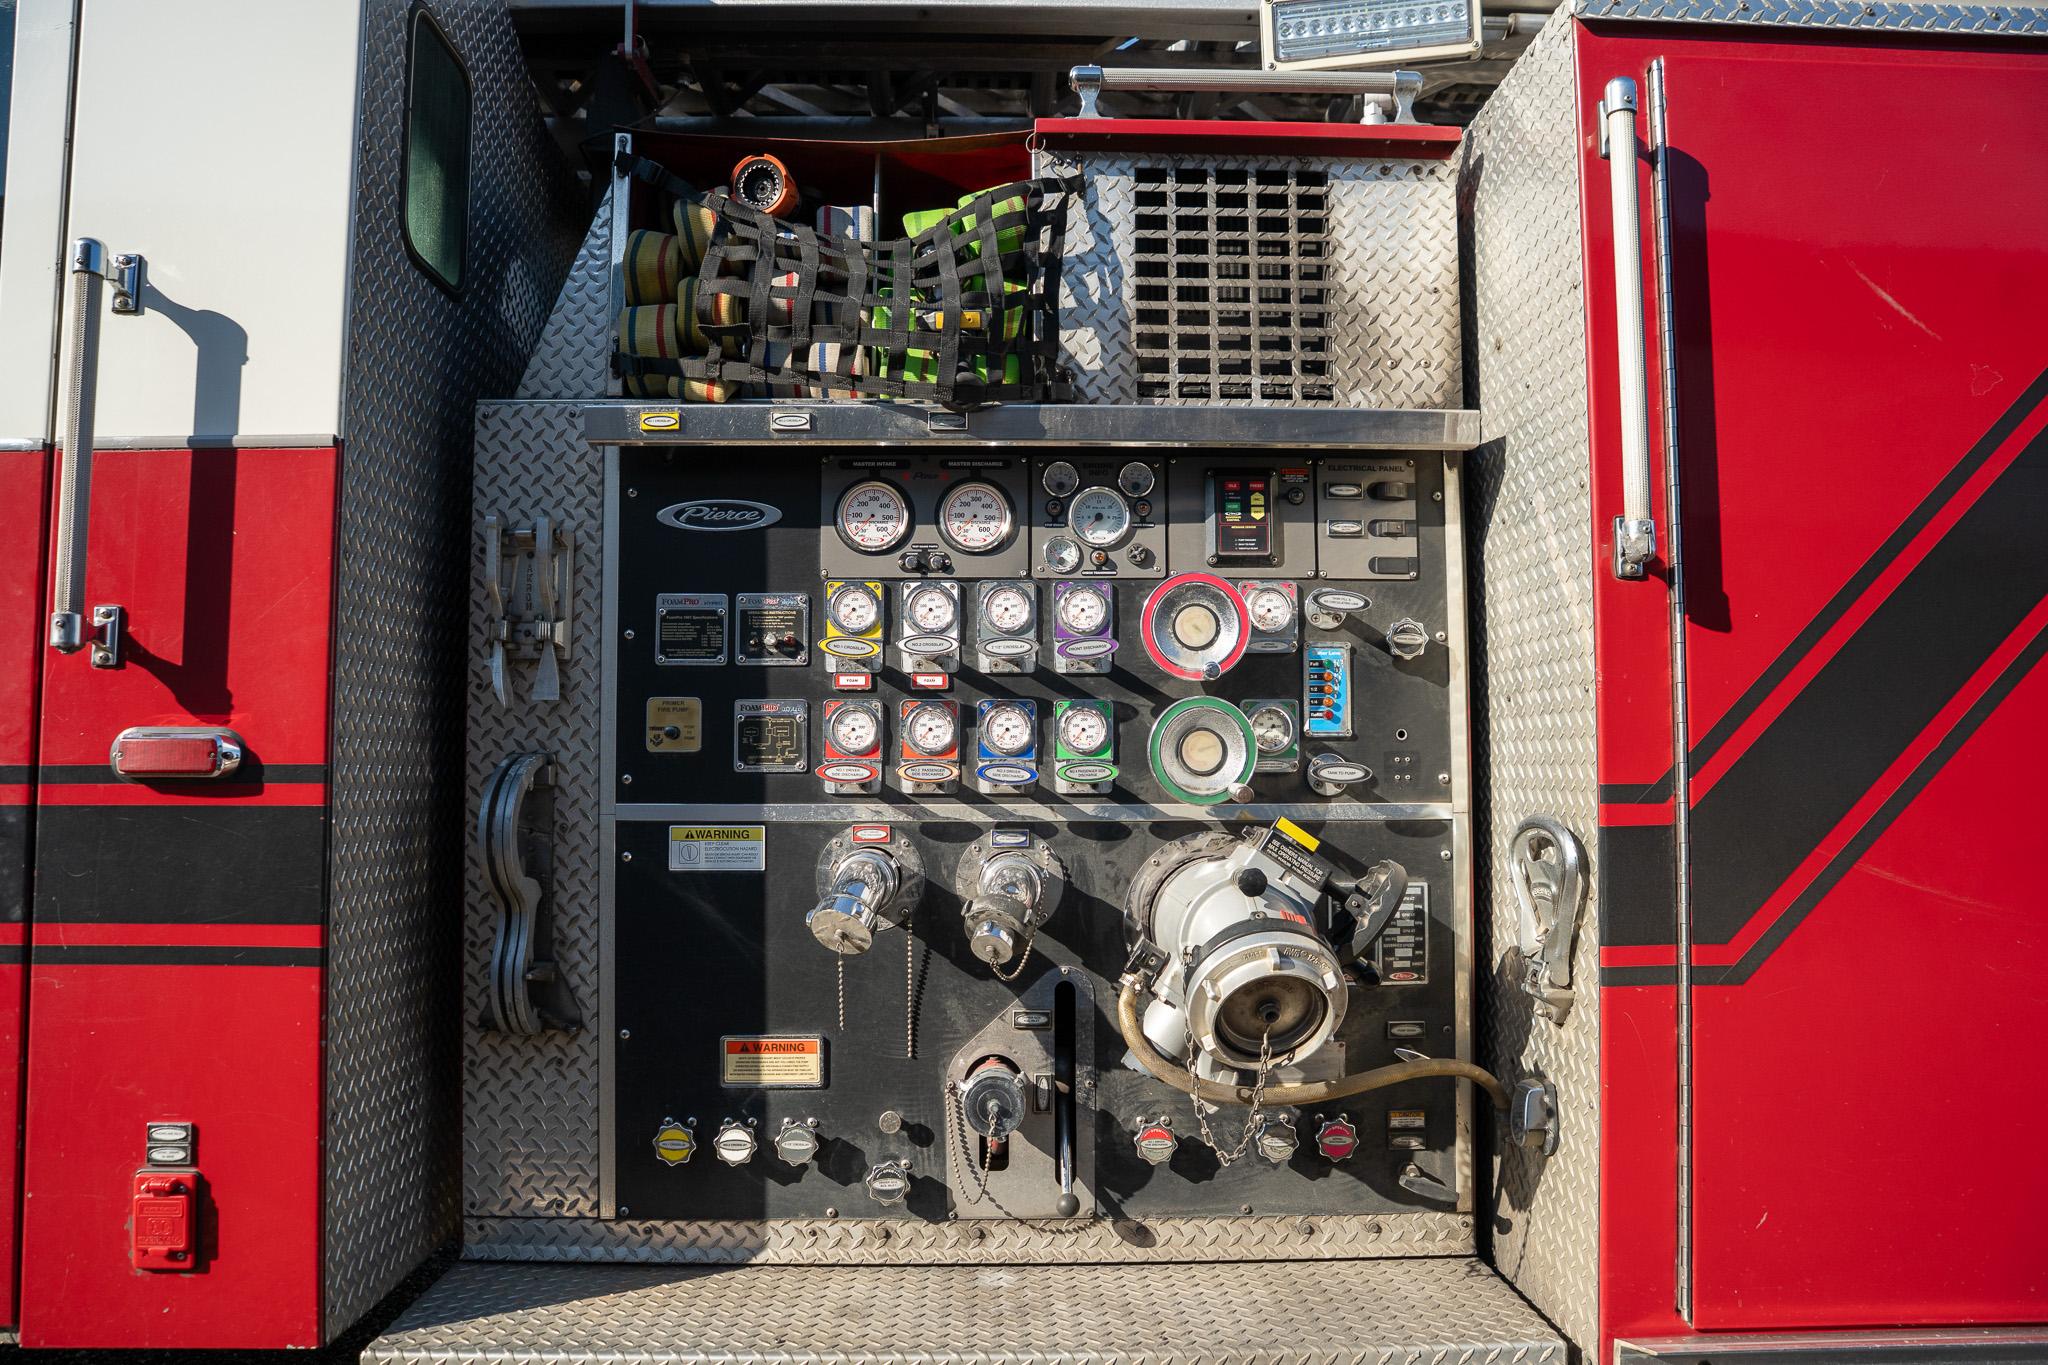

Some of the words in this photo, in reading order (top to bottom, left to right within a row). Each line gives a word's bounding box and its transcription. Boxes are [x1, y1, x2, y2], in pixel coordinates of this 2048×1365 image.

[857, 500, 869, 508] 200
[970, 495, 982, 503] 300
[879, 502, 891, 510] 400
[679, 506, 760, 522] Pierce
[695, 829, 750, 839] WARNING
[1267, 842, 1278, 852] MAX
[1299, 864, 1322, 882] PRESSURE
[1271, 839, 1281, 848] SEE
[1280, 844, 1299, 859] OWNERS
[1297, 856, 1314, 870] MANUAL
[1313, 867, 1324, 876] FOR
[752, 1042, 805, 1052] WARNING
